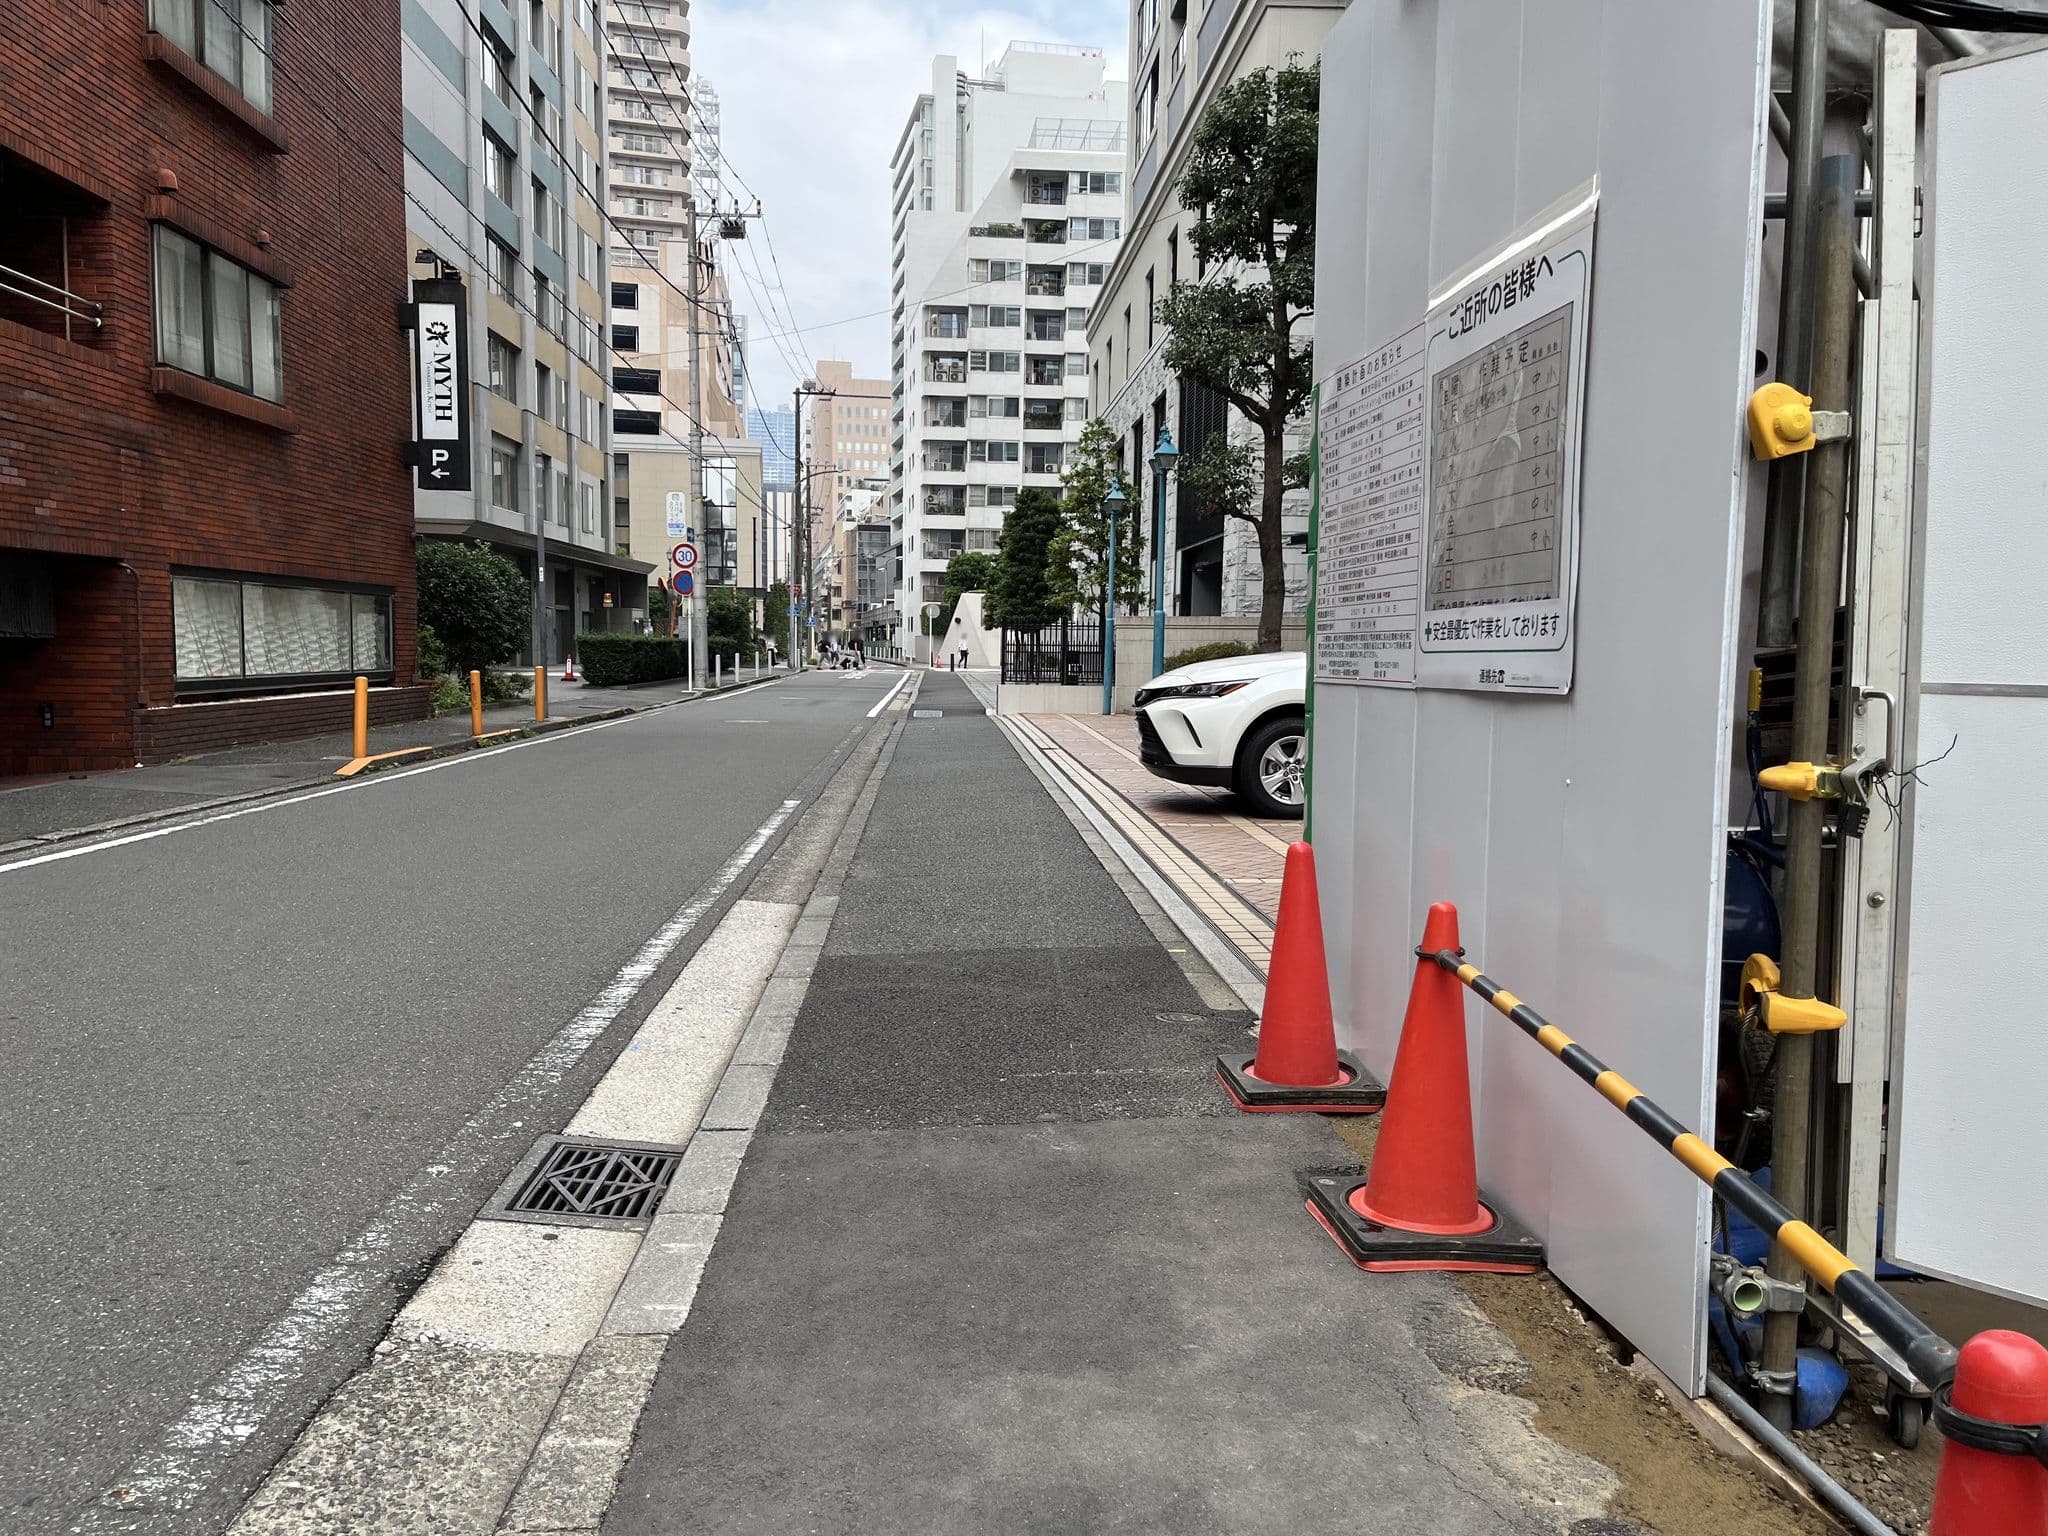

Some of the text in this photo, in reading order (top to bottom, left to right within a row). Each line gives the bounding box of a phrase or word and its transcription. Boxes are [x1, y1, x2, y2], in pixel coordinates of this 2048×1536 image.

[1448, 255, 1554, 339] ご近所の皆様へ
[434, 352, 452, 422] MYTH
[1336, 345, 1402, 392] 建築計画のお知らせ
[432, 449, 449, 466] P
[678, 550, 693, 562] 30
[1432, 612, 1560, 641] 安全最優先で作業をしております
